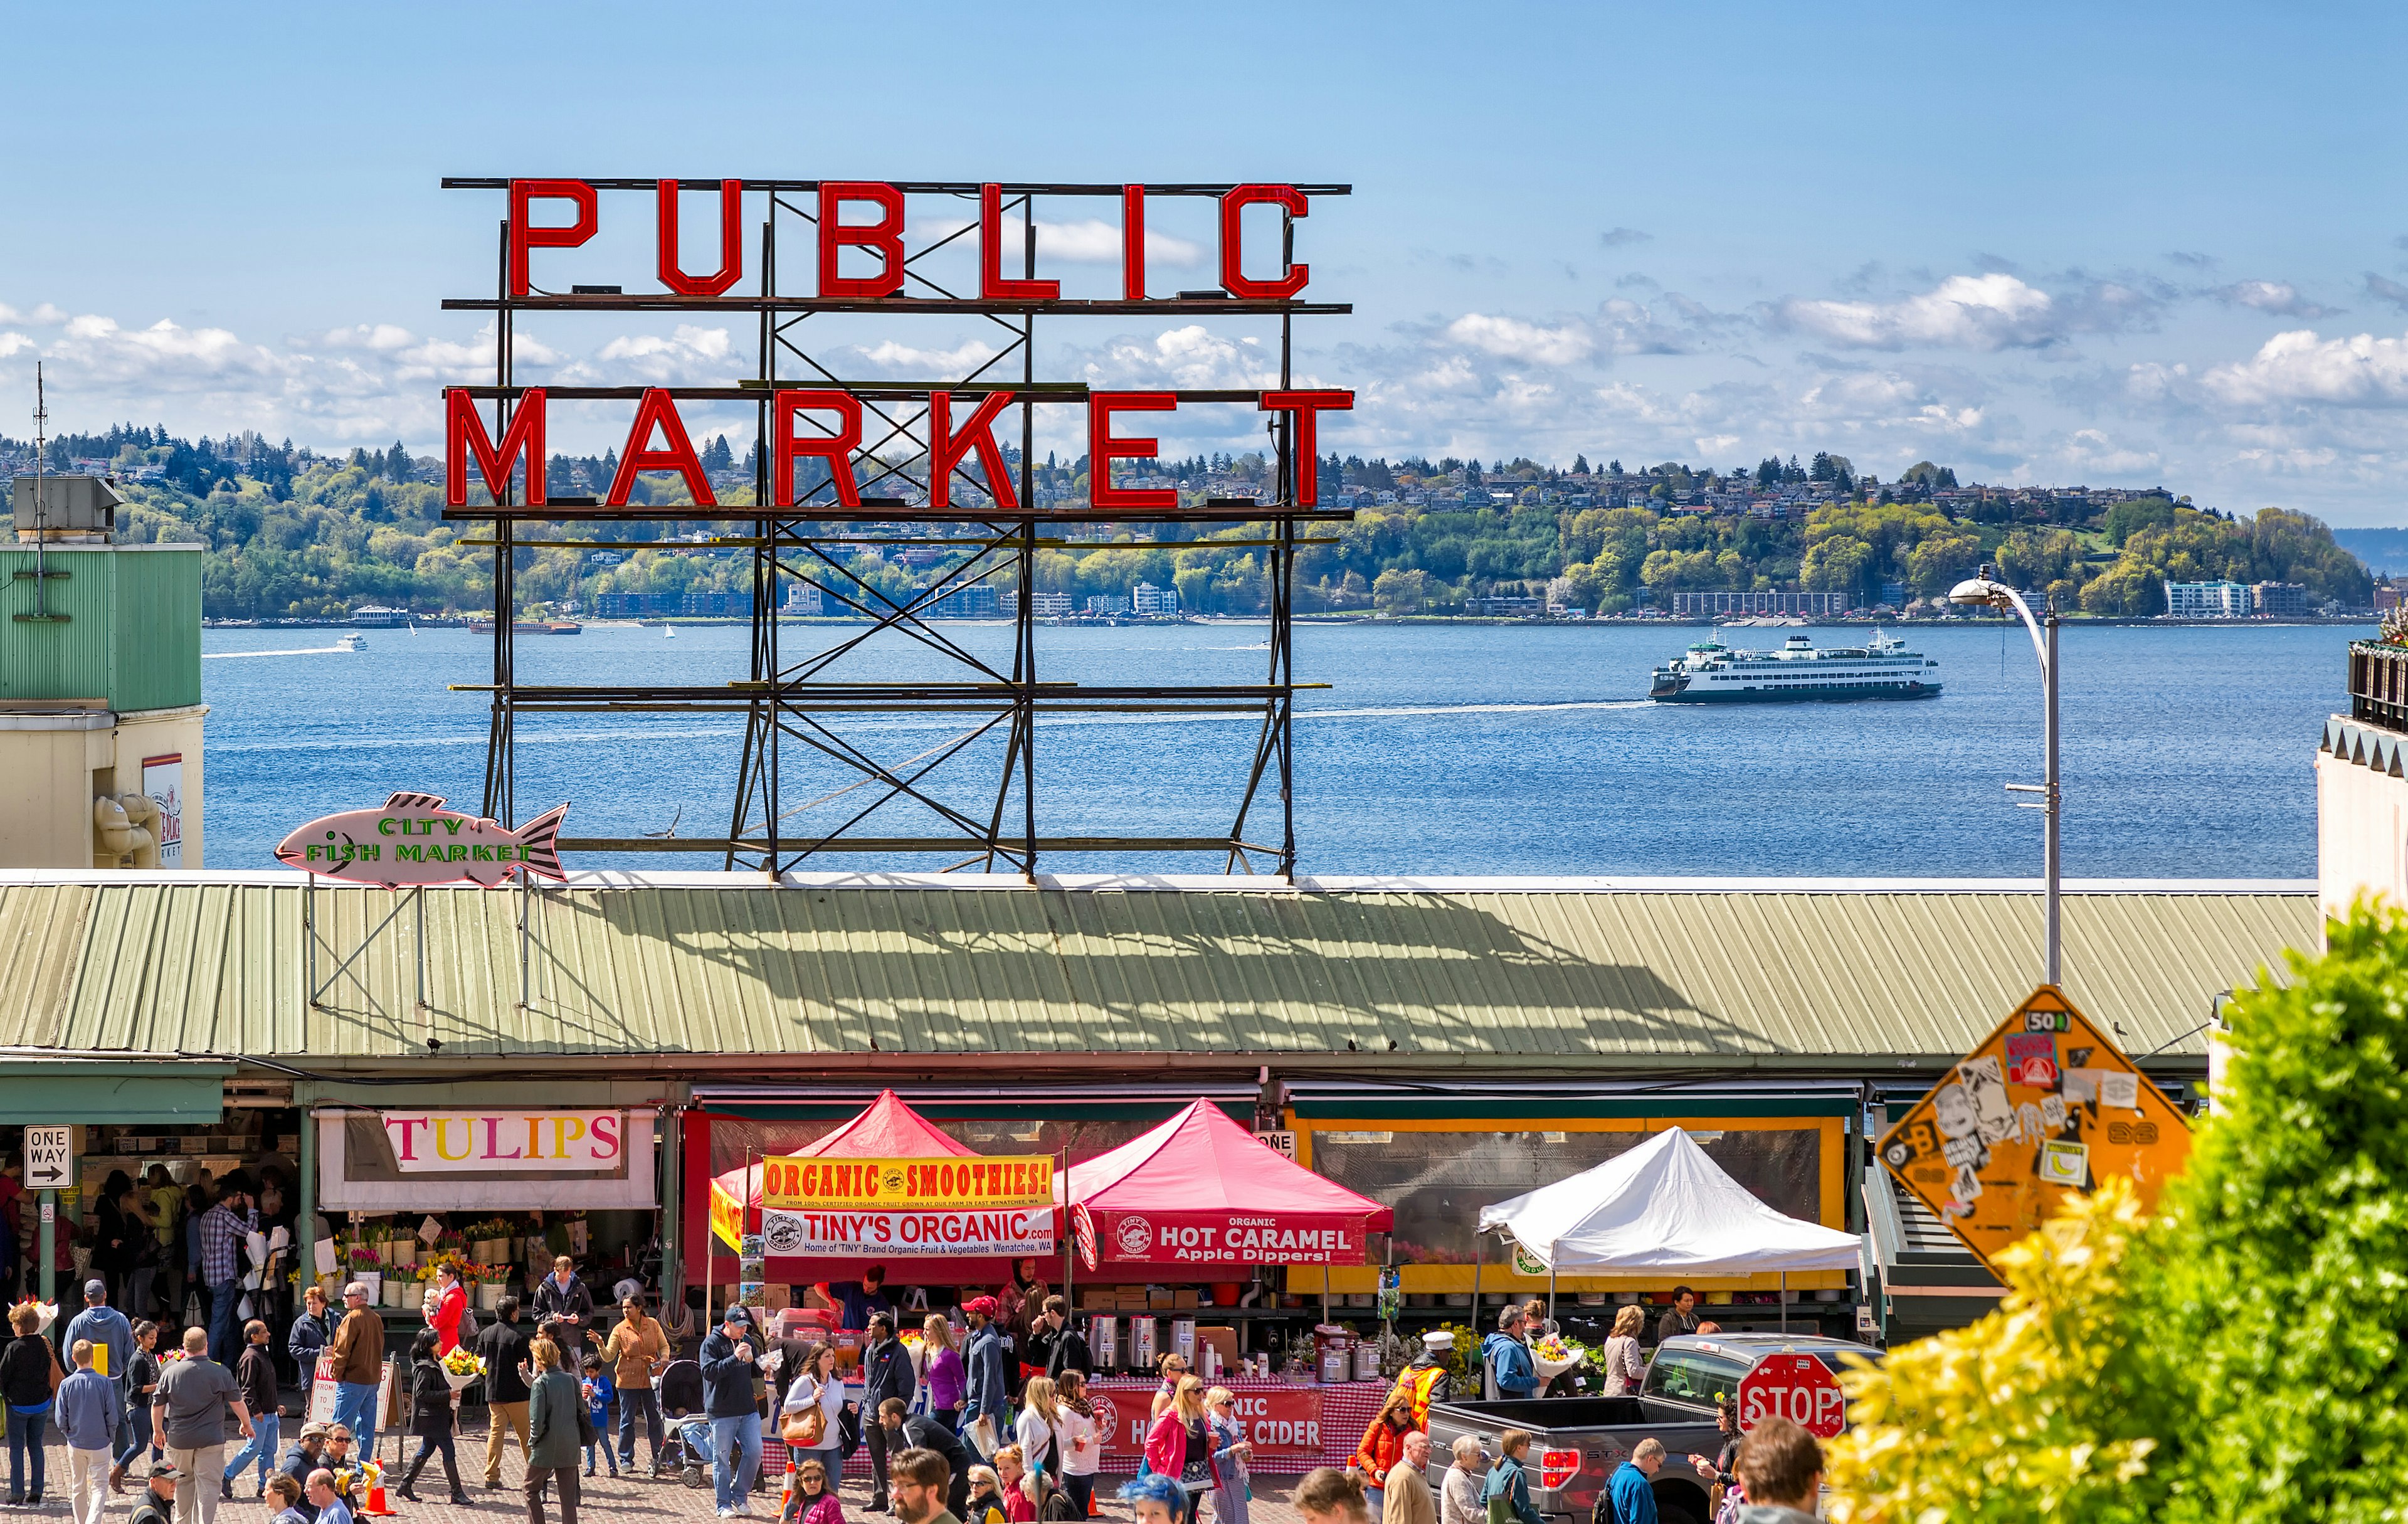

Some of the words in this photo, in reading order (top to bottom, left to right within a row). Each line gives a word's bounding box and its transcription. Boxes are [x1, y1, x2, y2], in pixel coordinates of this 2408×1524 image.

[509, 179, 1310, 300] PUBLIC
[445, 386, 1356, 511] MARKET
[166, 813, 180, 842] PLACE
[378, 817, 465, 836] CITY
[161, 846, 180, 859] RKET
[306, 844, 381, 862] FISH
[396, 844, 534, 862] MARKET
[31, 1131, 65, 1146] ONE
[385, 1116, 620, 1162] TULIPS
[31, 1148, 66, 1163] WAY
[766, 1163, 879, 1197] ORGANIC
[907, 1163, 1047, 1197] SMOOTHIES!
[771, 1215, 796, 1224] TINY'S
[1122, 1218, 1148, 1227] TINY'S
[1228, 1217, 1276, 1227] ORGANIC
[803, 1214, 892, 1242] TINY'S
[769, 1239, 797, 1249] ORGANIC
[1160, 1226, 1217, 1247] HOT
[1225, 1228, 1351, 1250] CARAMEL
[805, 1242, 826, 1252] Home
[829, 1242, 837, 1252] of
[863, 1244, 886, 1253] Brand
[888, 1244, 918, 1255] Organic
[921, 1245, 938, 1254] Fruit
[940, 1245, 946, 1254] &
[948, 1245, 989, 1255] Vegetables
[993, 1243, 1037, 1254] Wenatchee,
[1039, 1241, 1052, 1251] WA
[1121, 1242, 1147, 1252] ORGANIC
[1175, 1248, 1235, 1262] Apple
[1242, 1249, 1331, 1263] Dippers!
[1747, 1386, 1836, 1426] STOP
[1254, 1420, 1321, 1446] CIDER
[1587, 1450, 1629, 1459] STX
